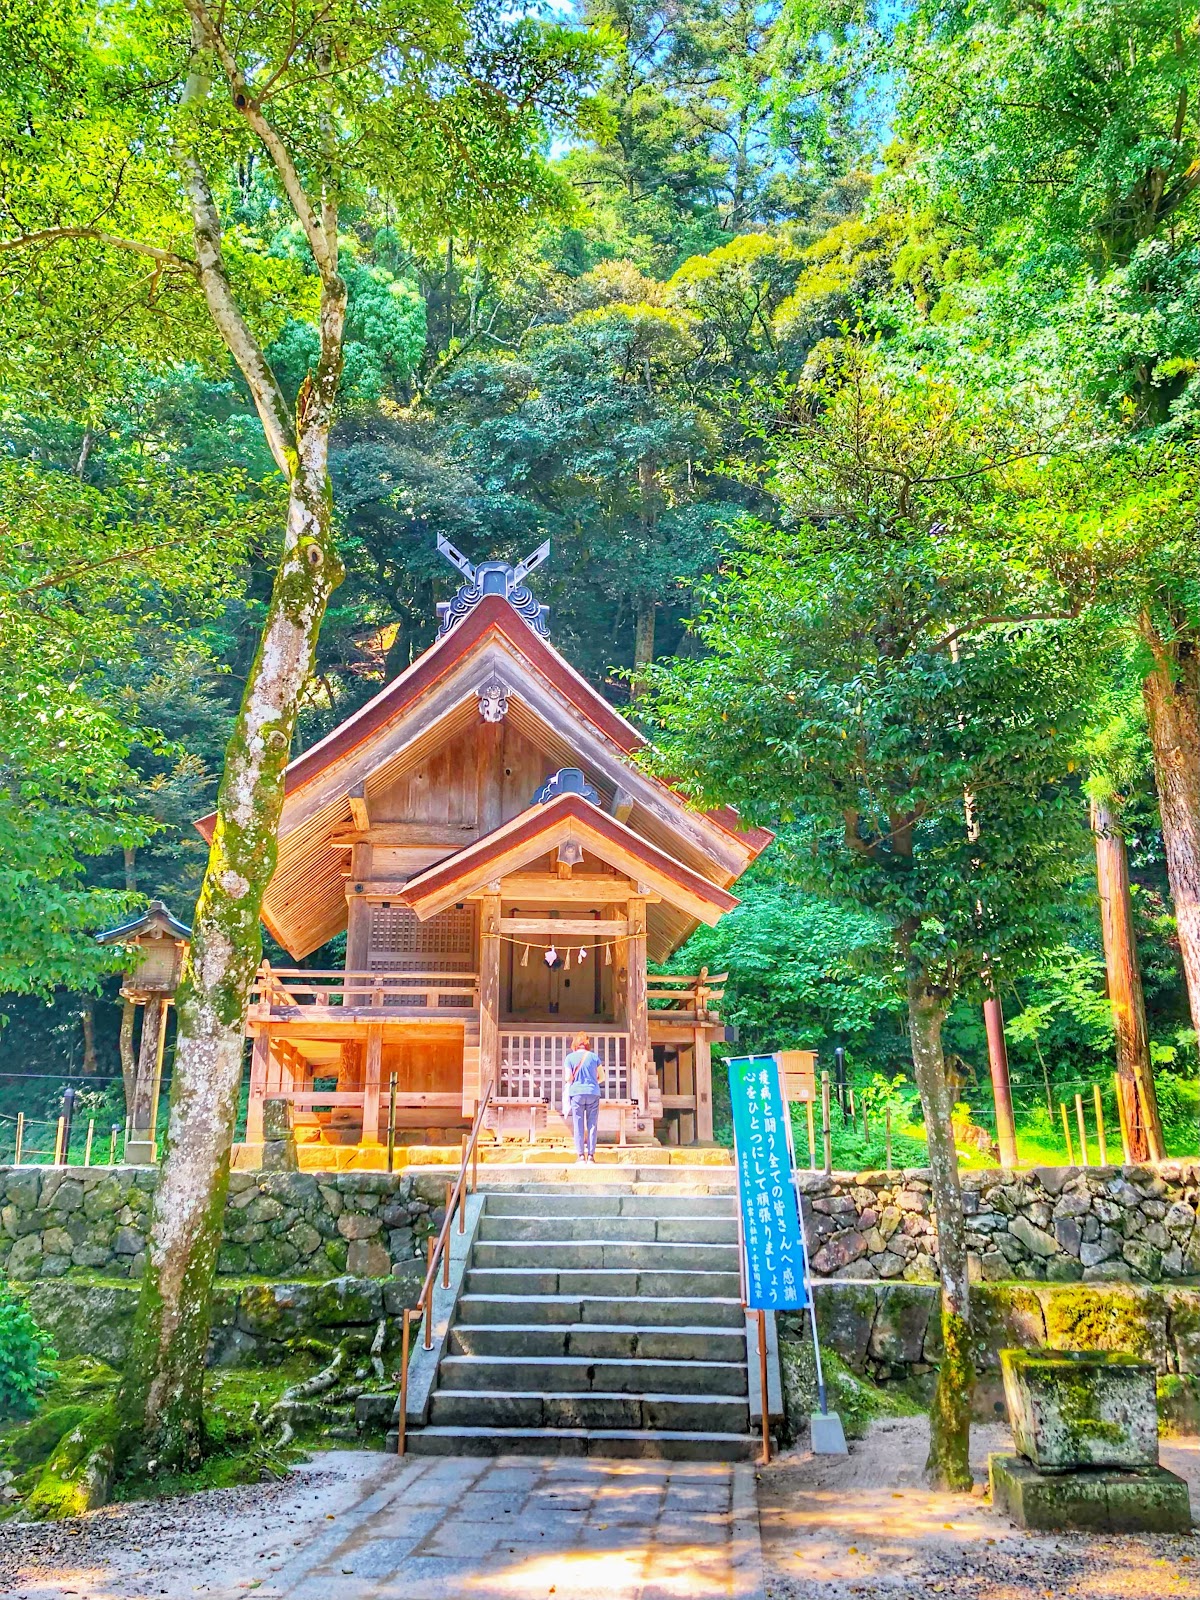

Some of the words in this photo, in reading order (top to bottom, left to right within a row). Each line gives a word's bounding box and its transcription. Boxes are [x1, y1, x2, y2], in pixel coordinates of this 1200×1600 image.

[742, 1072, 779, 1303] 心をひとつにして頑張りましょう
[758, 1068, 797, 1301] 疫病と闘う全ての皆さんへ感謝
